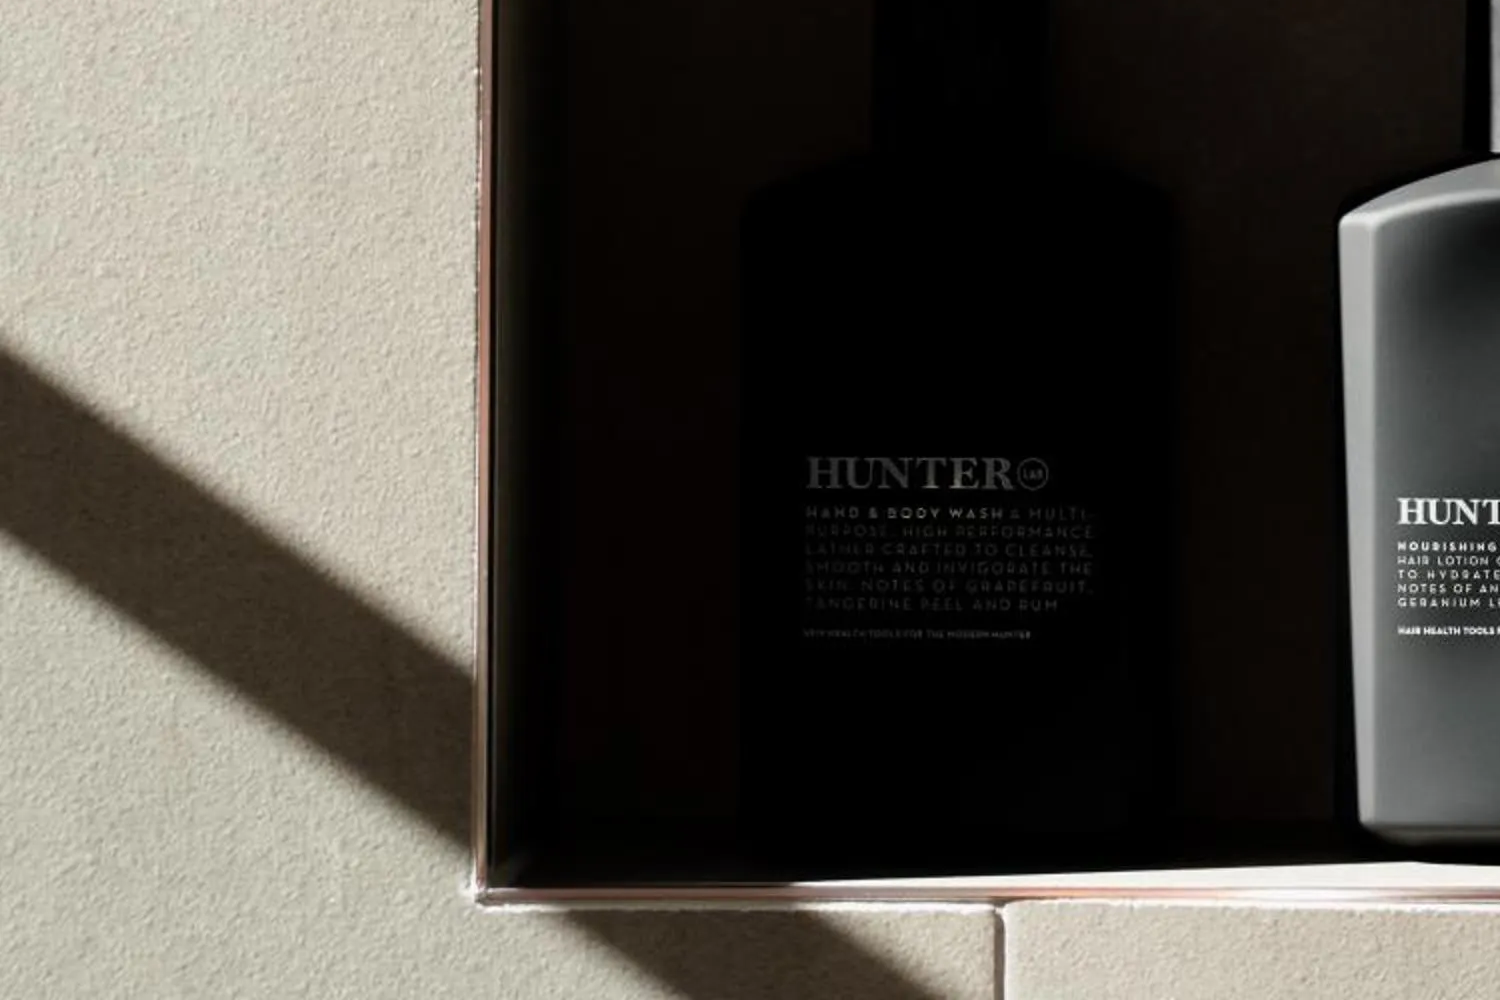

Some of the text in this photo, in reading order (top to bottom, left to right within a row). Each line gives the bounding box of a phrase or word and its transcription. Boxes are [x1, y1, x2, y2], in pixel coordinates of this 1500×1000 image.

[805, 456, 1016, 490] HUNTER
[805, 506, 859, 520] HAND
[868, 506, 878, 520] &
[888, 506, 940, 520] BODY
[949, 506, 1003, 520] WASH
[902, 524, 947, 538] HIGH
[956, 524, 1095, 538] PERFORMANCE
[881, 542, 966, 557] CRAFTED
[974, 542, 998, 557] TO
[1397, 542, 1497, 552] NOURISHING
[892, 561, 929, 575] AND
[937, 561, 1050, 575] INVIGORATE
[1060, 561, 1093, 575] THE
[1397, 556, 1430, 566] HAIR
[1437, 556, 1489, 566] LOTION
[1398, 570, 1418, 580] TO
[1428, 570, 1500, 580] HYDRATE
[861, 579, 924, 593] NOTES
[932, 579, 955, 593] OF
[1397, 584, 1446, 595] NOTES
[1453, 584, 1472, 595] OF
[921, 597, 963, 611] PEEL
[972, 597, 1011, 611] AND
[1019, 597, 1058, 611] RUM
[1398, 598, 1480, 608] GERANIUM
[1397, 626, 1421, 636] HAIR
[1424, 626, 1461, 636] HEALTH
[1464, 626, 1495, 636] TOOLS
